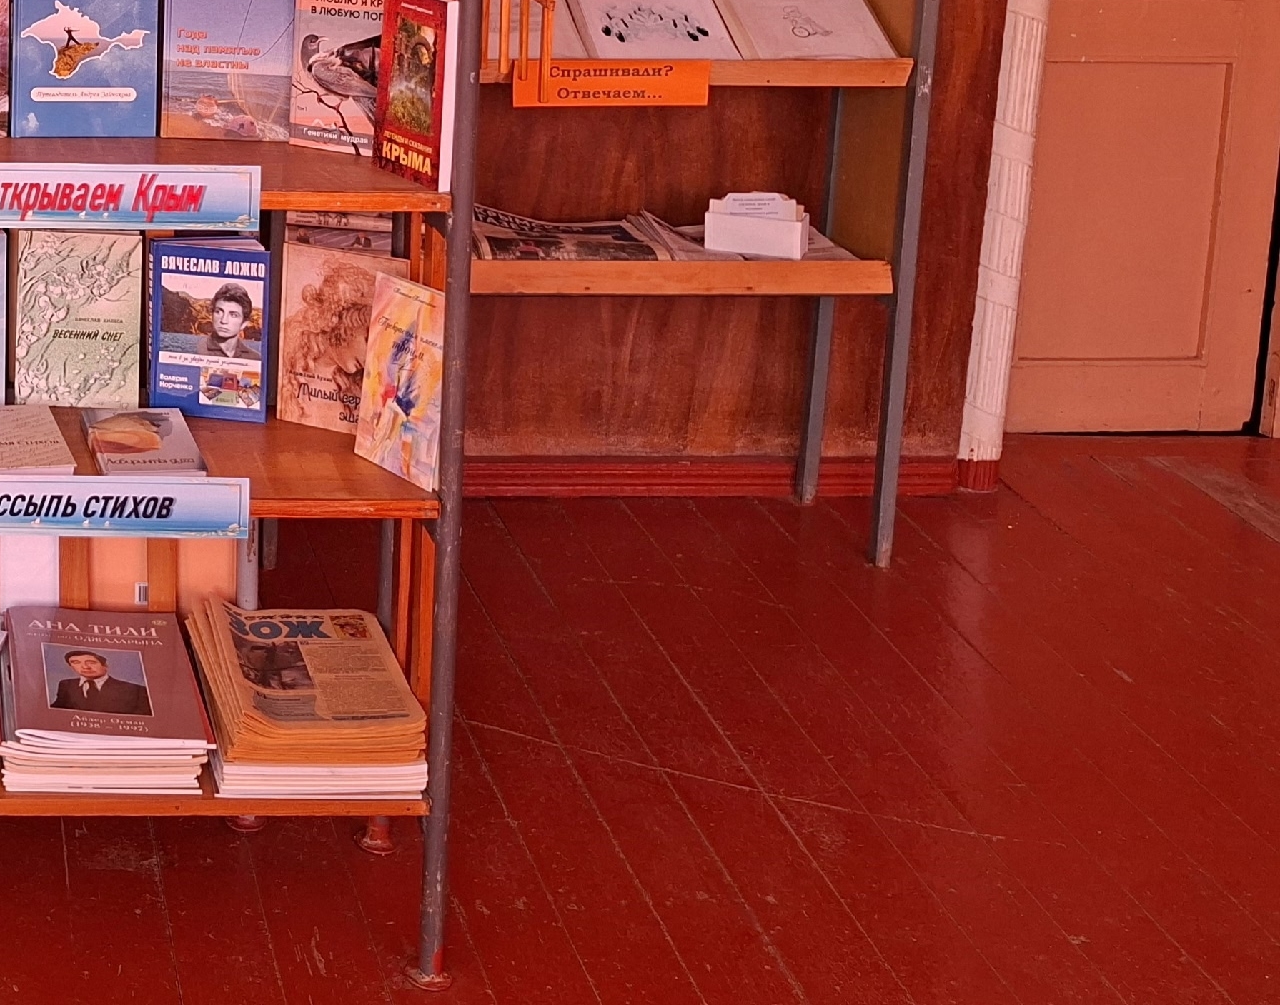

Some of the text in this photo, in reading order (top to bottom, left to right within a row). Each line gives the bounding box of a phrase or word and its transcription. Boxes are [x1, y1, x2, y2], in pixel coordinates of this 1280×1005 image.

[311, 6, 385, 22] В ЛЮБУЮ ПОГ
[177, 27, 208, 41] Года
[177, 44, 261, 58] над памятью
[177, 59, 249, 71] не властны
[548, 65, 674, 81] Спрашивали?
[556, 87, 663, 100] Отвечаем...
[382, 140, 432, 176] КРЫМА
[132, 174, 207, 222] Крым
[161, 255, 265, 278] ВЯЧЕСЛАВ ЛОЖКО
[52, 328, 125, 343] ВЕСЕННИЙ СНЕГ
[297, 382, 338, 402] Милый
[82, 494, 175, 520] стихов
[28, 619, 158, 637] АНА ТИЛИ
